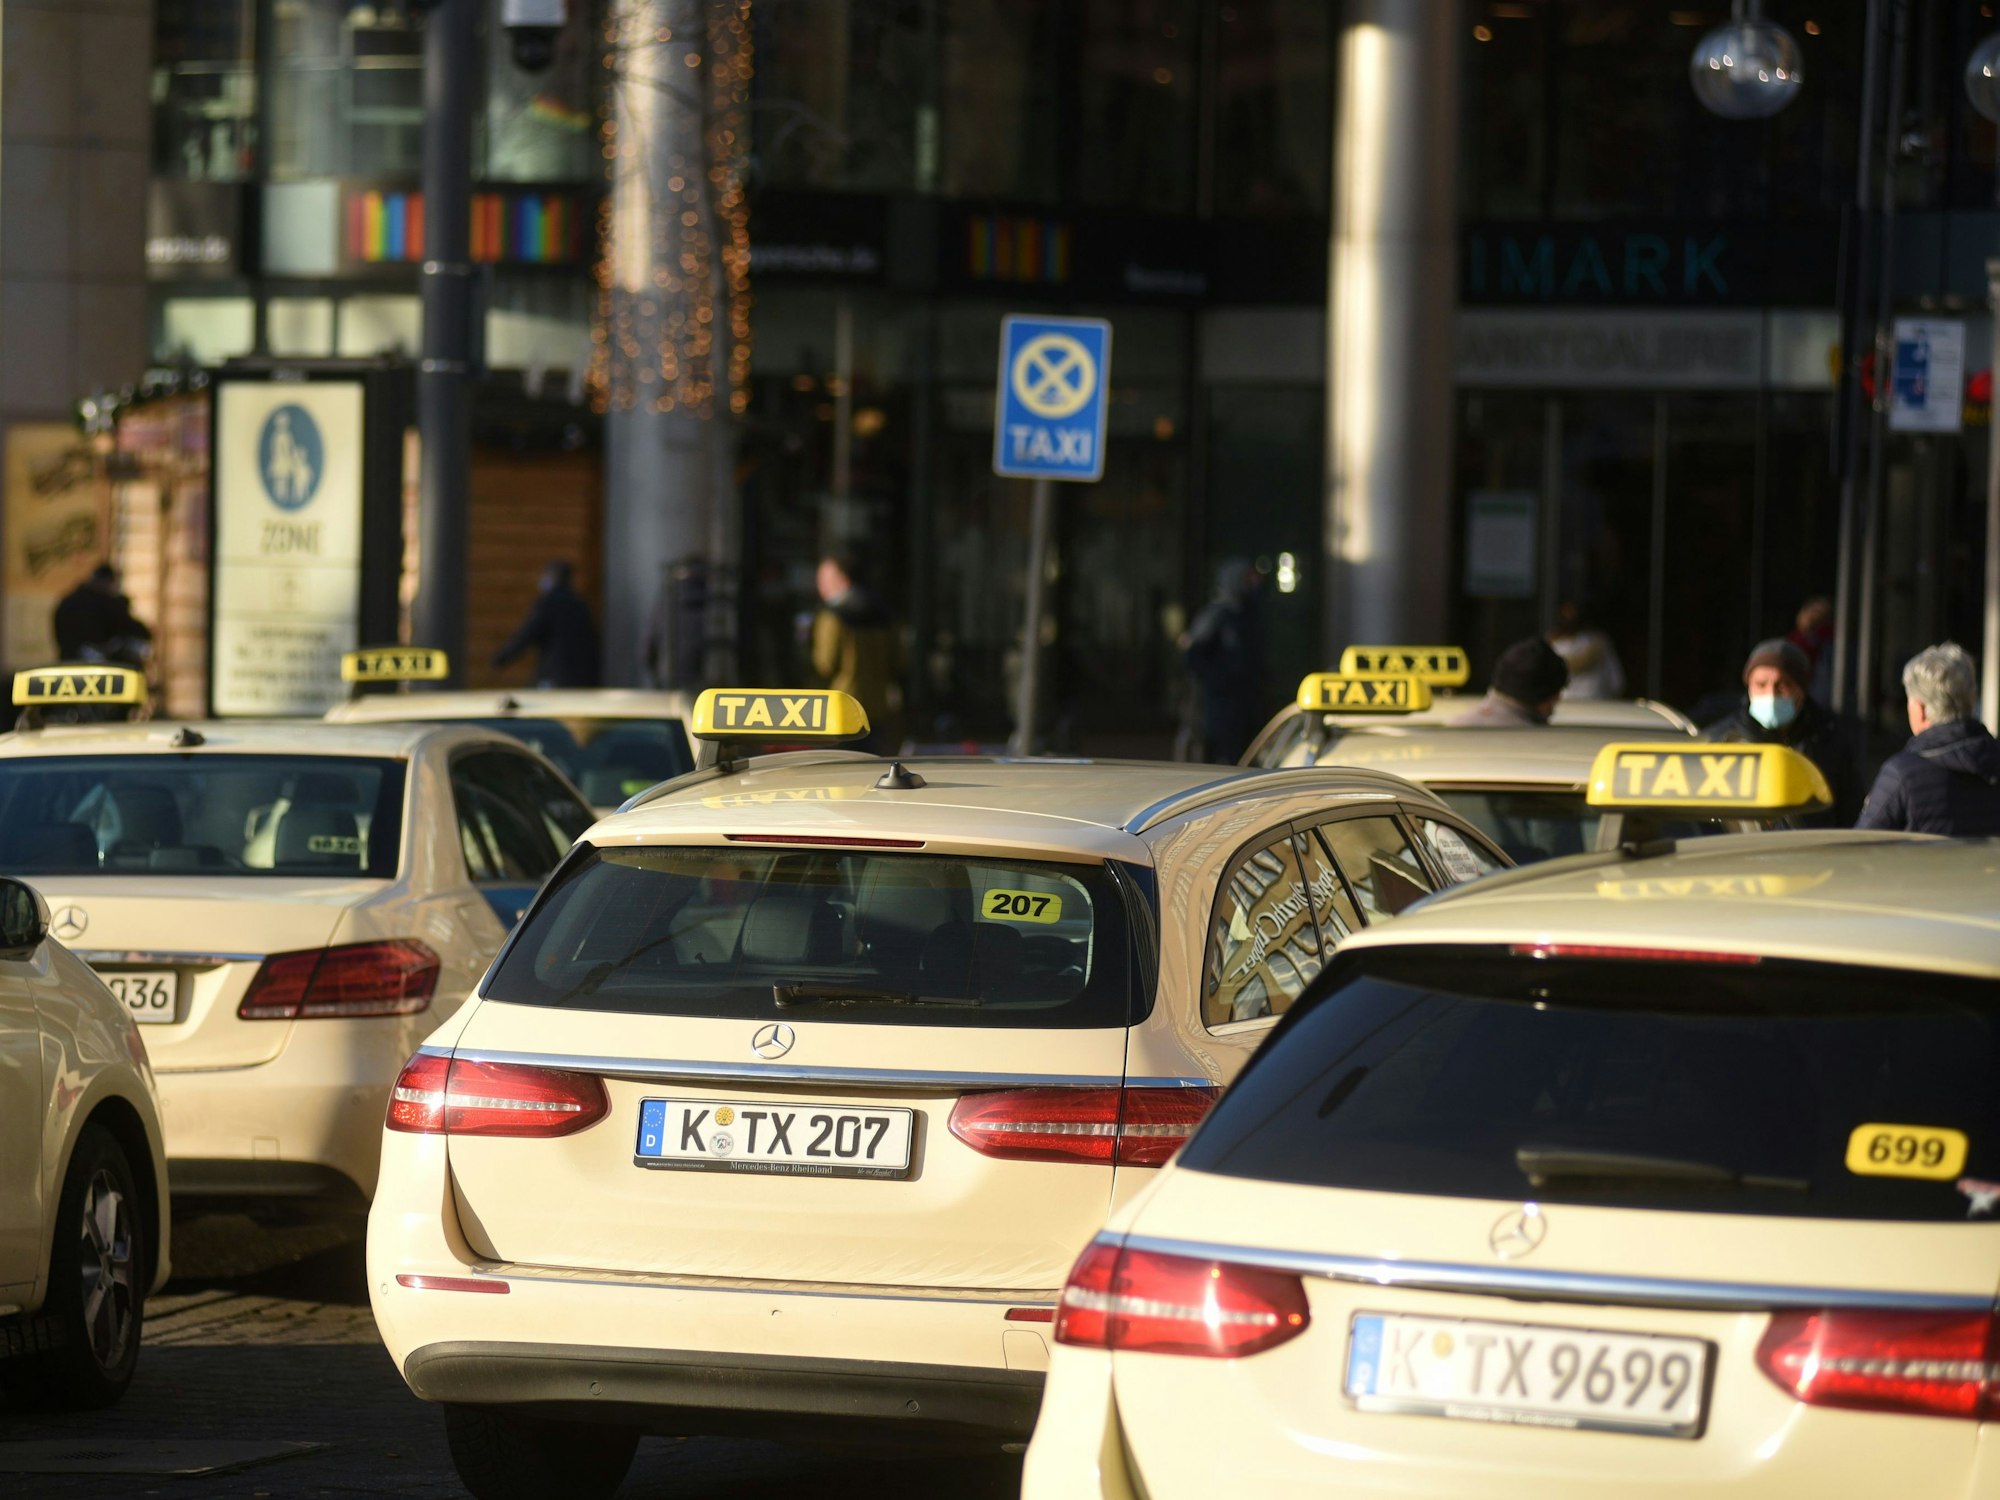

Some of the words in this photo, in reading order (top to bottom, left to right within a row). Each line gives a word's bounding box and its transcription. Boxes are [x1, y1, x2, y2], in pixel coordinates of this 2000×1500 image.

[1008, 424, 1091, 466] TAXI
[260, 519, 324, 555] ZONE
[366, 654, 425, 674] TAXI
[1363, 655, 1448, 673] TAXI
[39, 675, 114, 696] TAXI
[1323, 681, 1407, 705] TAXI
[718, 697, 823, 728] TAXI
[1619, 754, 1759, 798] TAXI
[991, 893, 1051, 917] 207
[646, 1134, 656, 1147] D
[680, 1109, 710, 1152] K
[741, 1111, 796, 1155] TX
[806, 1114, 890, 1159] 207
[1868, 1133, 1946, 1167] 699
[730, 1161, 790, 1173] Mercedes-Benz
[791, 1164, 833, 1174] Rheinland
[1391, 1328, 1425, 1389] K
[1466, 1333, 1534, 1397] TX
[1550, 1342, 1693, 1411] 9699
